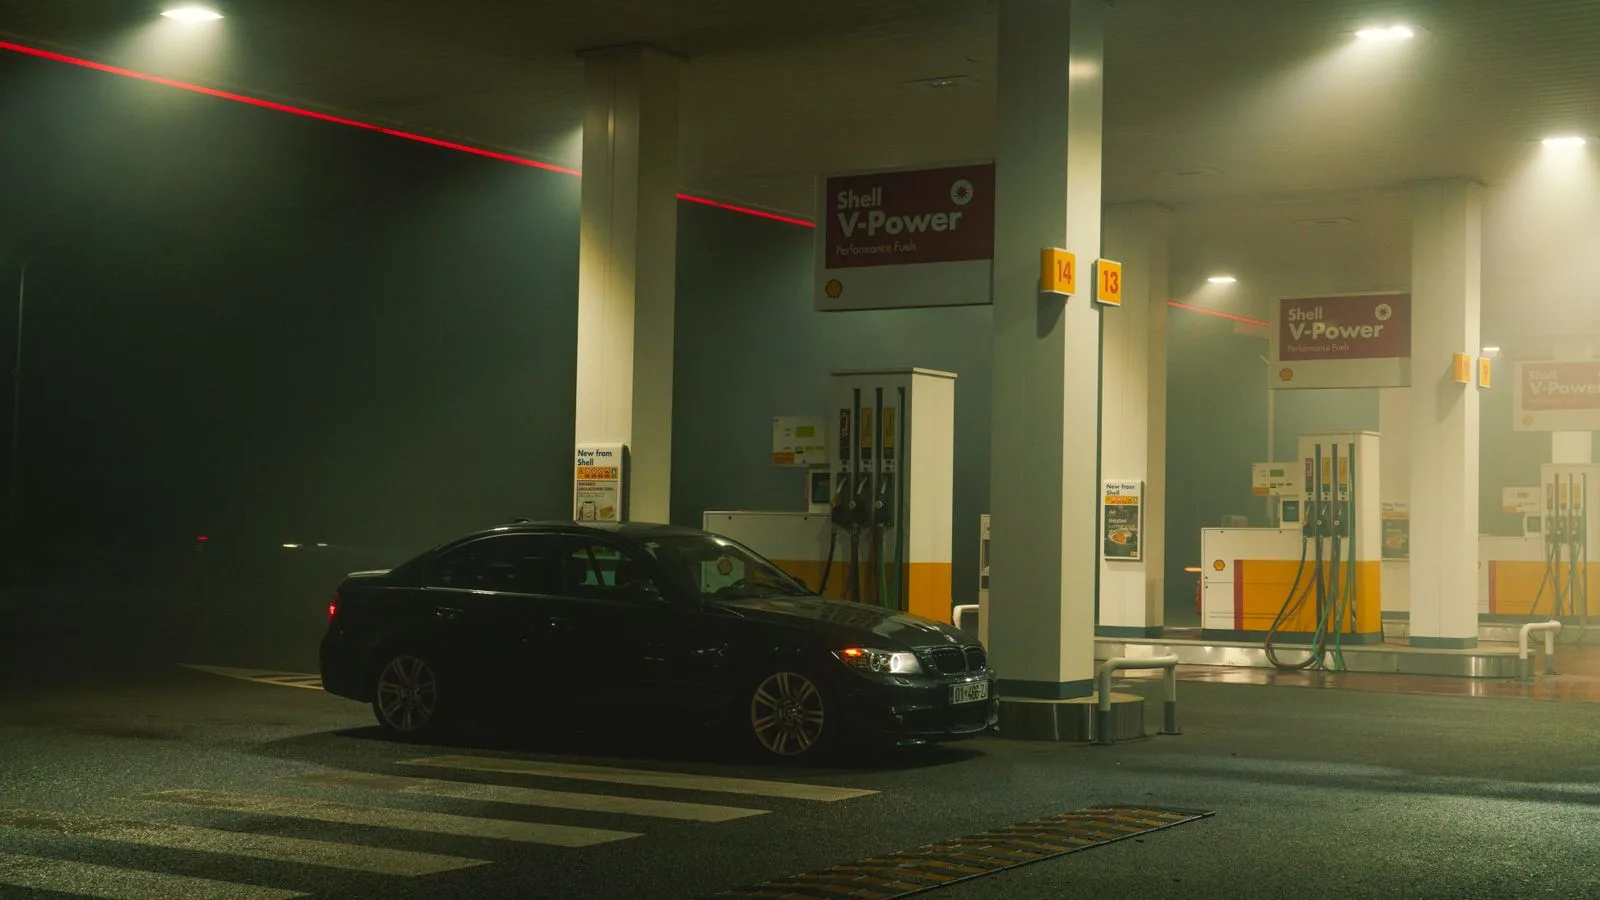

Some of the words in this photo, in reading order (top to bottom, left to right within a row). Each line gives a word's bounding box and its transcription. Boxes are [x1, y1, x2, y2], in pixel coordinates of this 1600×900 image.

[836, 186, 882, 210] Shell
[836, 210, 962, 238] V-Power
[836, 243, 891, 256] Performance
[893, 238, 917, 252] Fuels
[1057, 258, 1072, 284] 14
[1103, 270, 1119, 294] 13
[1287, 306, 1323, 322] Shell
[1288, 321, 1384, 341] V-Power
[1528, 369, 1557, 381] Shell
[1529, 381, 1600, 395] V-Powe
[578, 449, 594, 457] New
[596, 449, 613, 457] from
[578, 458, 593, 466] Shell
[955, 688, 963, 702] 01
